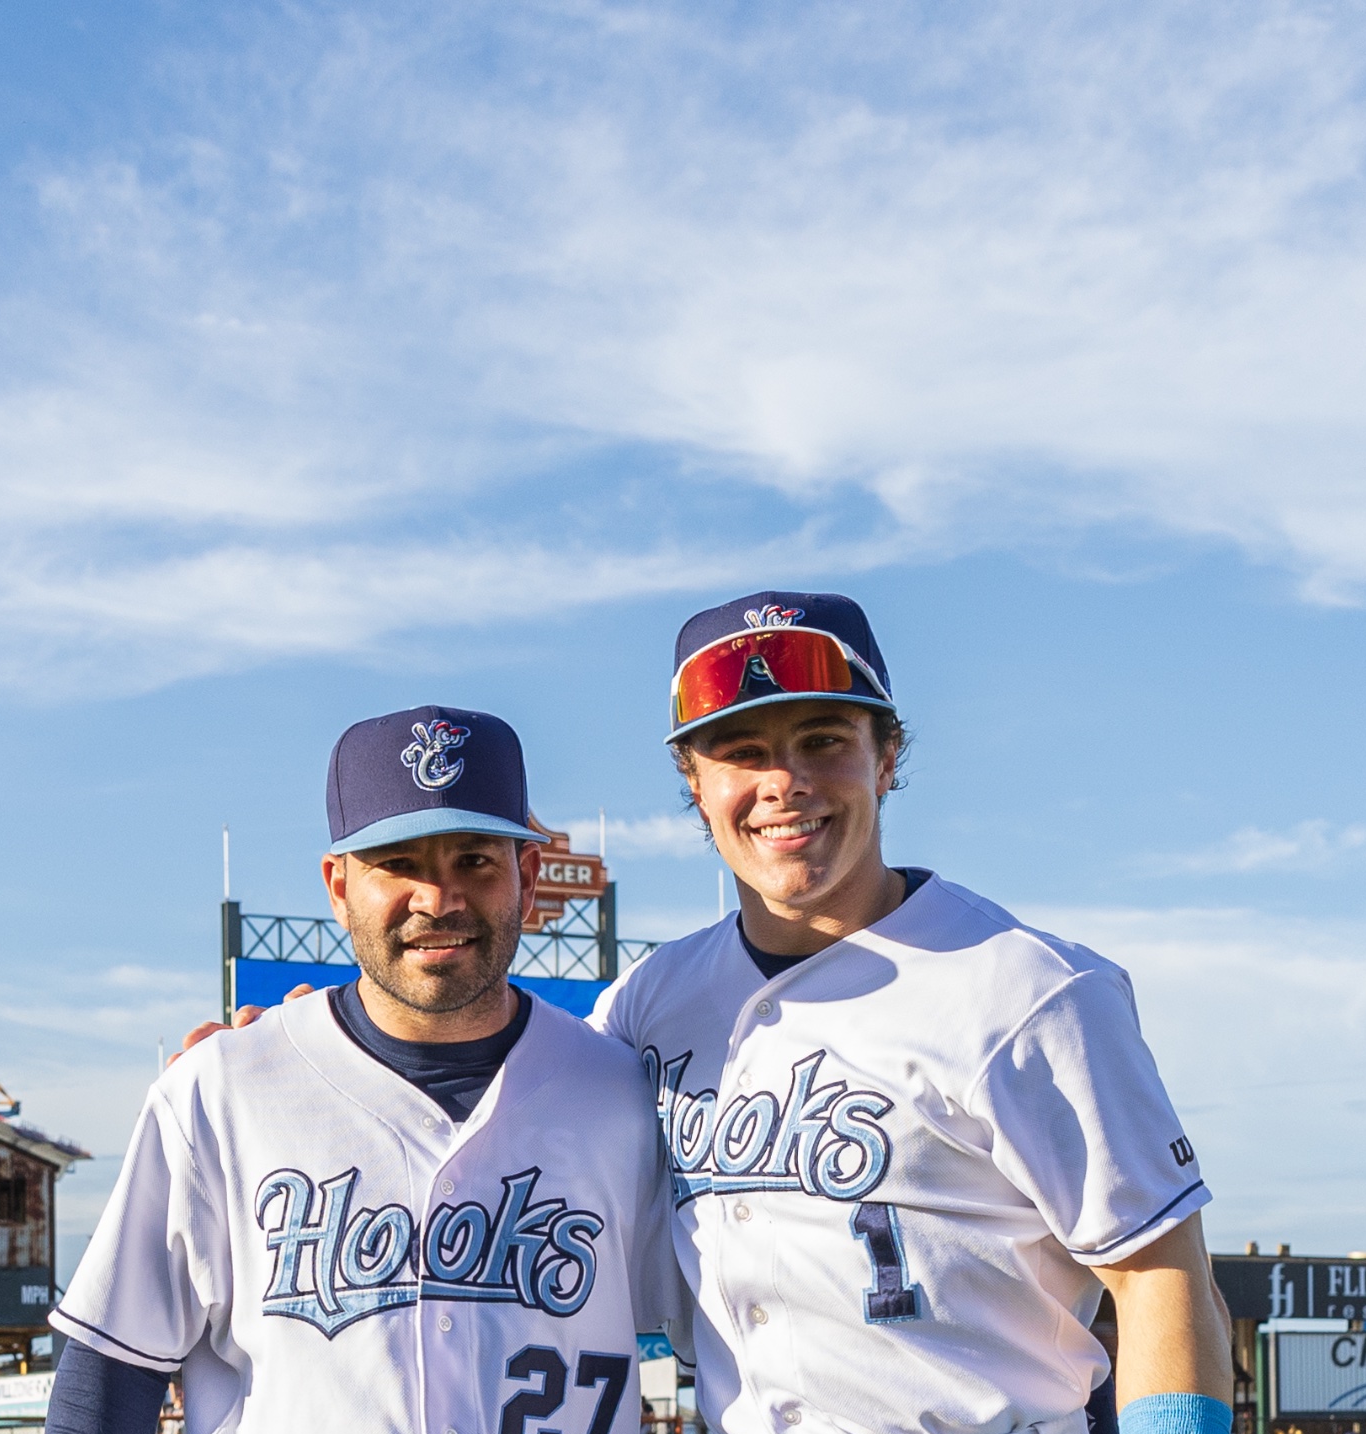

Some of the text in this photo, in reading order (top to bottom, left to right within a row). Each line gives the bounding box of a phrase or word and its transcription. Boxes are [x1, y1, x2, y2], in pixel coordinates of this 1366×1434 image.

[21, 1285, 49, 1304] MPH
[255, 1166, 604, 1318] Hooks
[849, 1200, 922, 1324] 1
